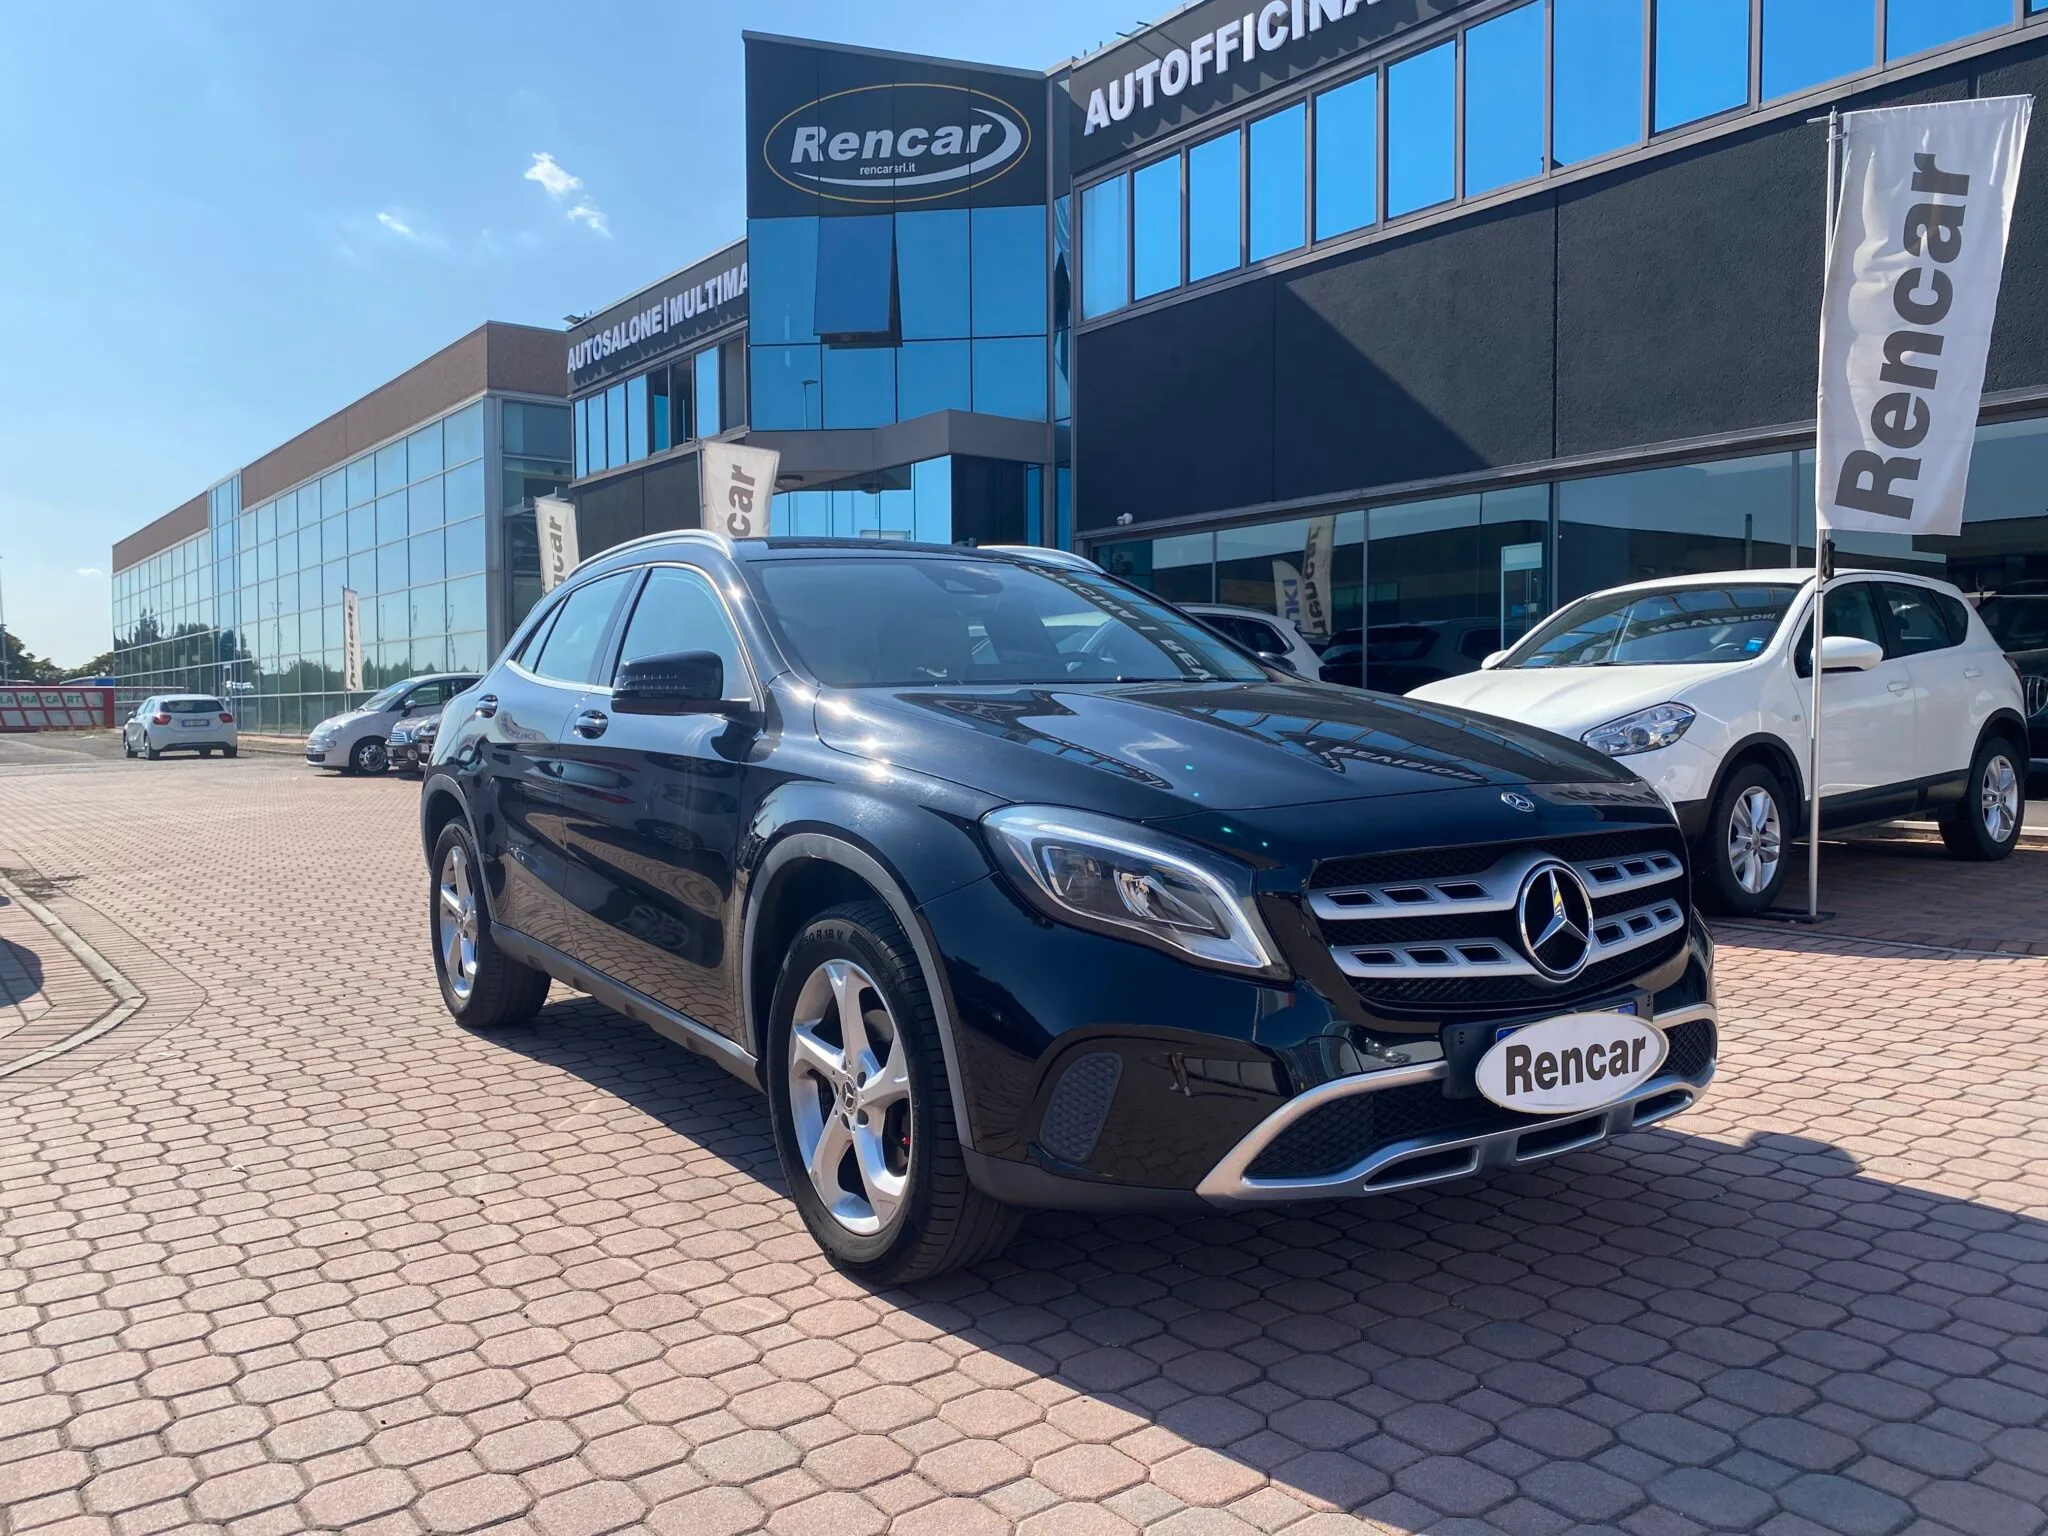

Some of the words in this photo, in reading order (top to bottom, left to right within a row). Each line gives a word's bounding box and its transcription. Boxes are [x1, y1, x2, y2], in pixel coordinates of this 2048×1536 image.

[1084, 0, 1384, 136] AUTOFFICIN
[790, 122, 993, 163] Rencar
[860, 162, 916, 175] rencarsrl.it
[567, 304, 662, 374] AUTOSALONE
[1834, 152, 1970, 520] Rencar
[1506, 1035, 1646, 1096] Rencar
